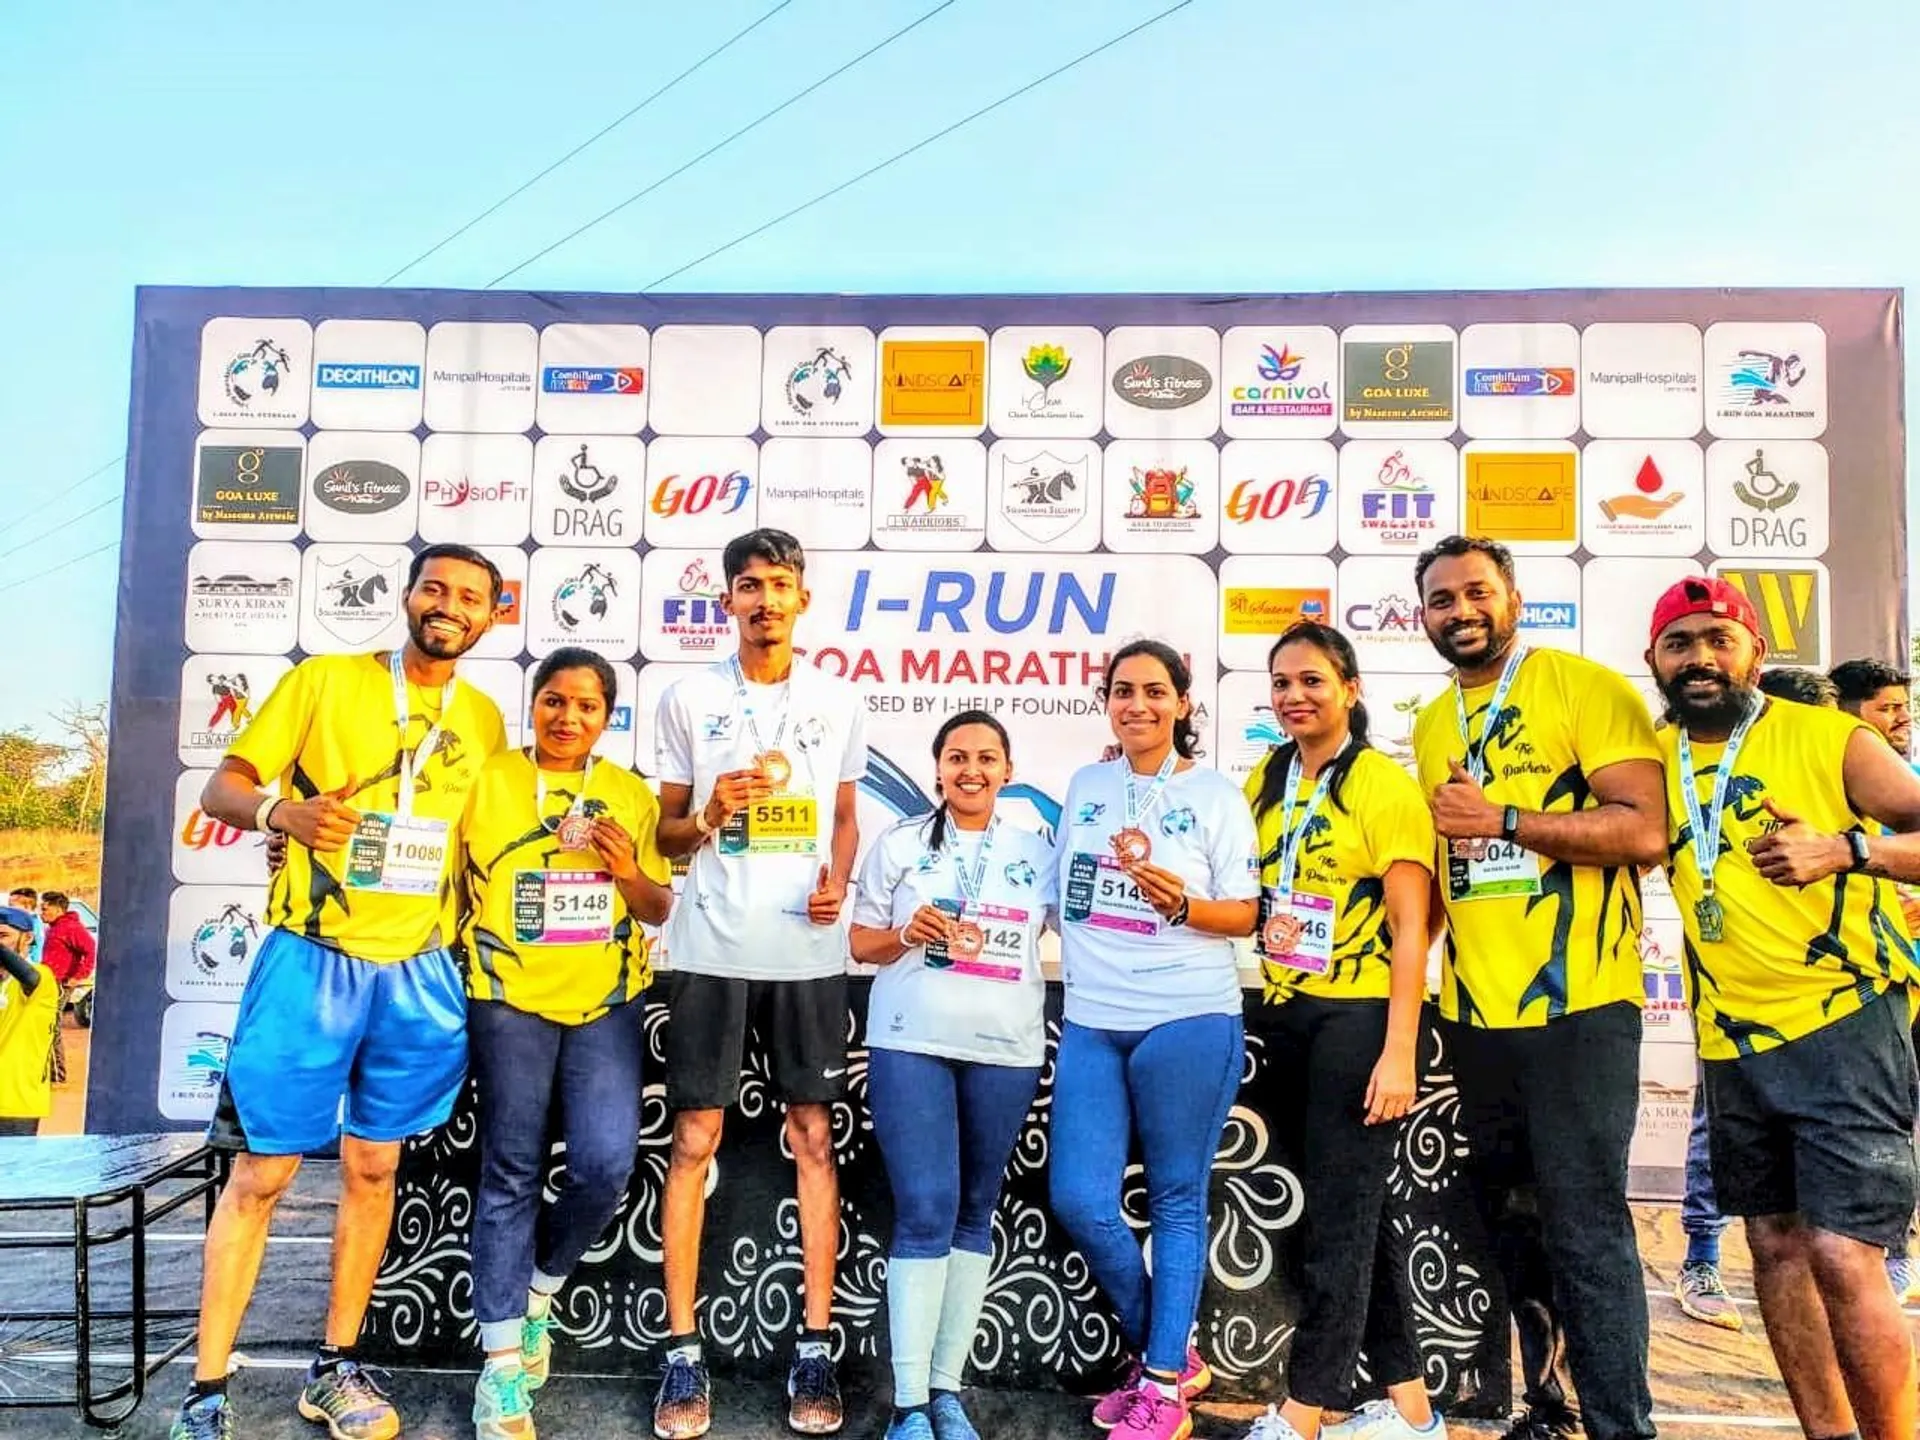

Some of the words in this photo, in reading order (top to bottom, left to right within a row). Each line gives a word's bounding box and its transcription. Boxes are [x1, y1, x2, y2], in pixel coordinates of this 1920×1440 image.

[322, 367, 415, 385] DECATHLON
[1232, 381, 1331, 401] carnival
[1363, 386, 1393, 399] GOA
[1396, 386, 1430, 399] LUXE
[216, 490, 243, 501] GOA
[246, 490, 279, 501] LUXE
[1363, 494, 1435, 518] FIT
[553, 508, 623, 537] DRAG
[1730, 517, 1807, 547] DRAG
[198, 598, 240, 608] SURYA
[245, 598, 286, 609] KIRAN
[845, 570, 1117, 634] I-RUN
[792, 648, 884, 683] OA
[901, 650, 1108, 686] MARATH
[864, 696, 904, 713] SED
[914, 696, 936, 713] BY
[756, 805, 809, 823] 5511
[393, 844, 443, 861] 10080
[553, 893, 608, 912] 5148
[1655, 1107, 1690, 1119] KIRA
